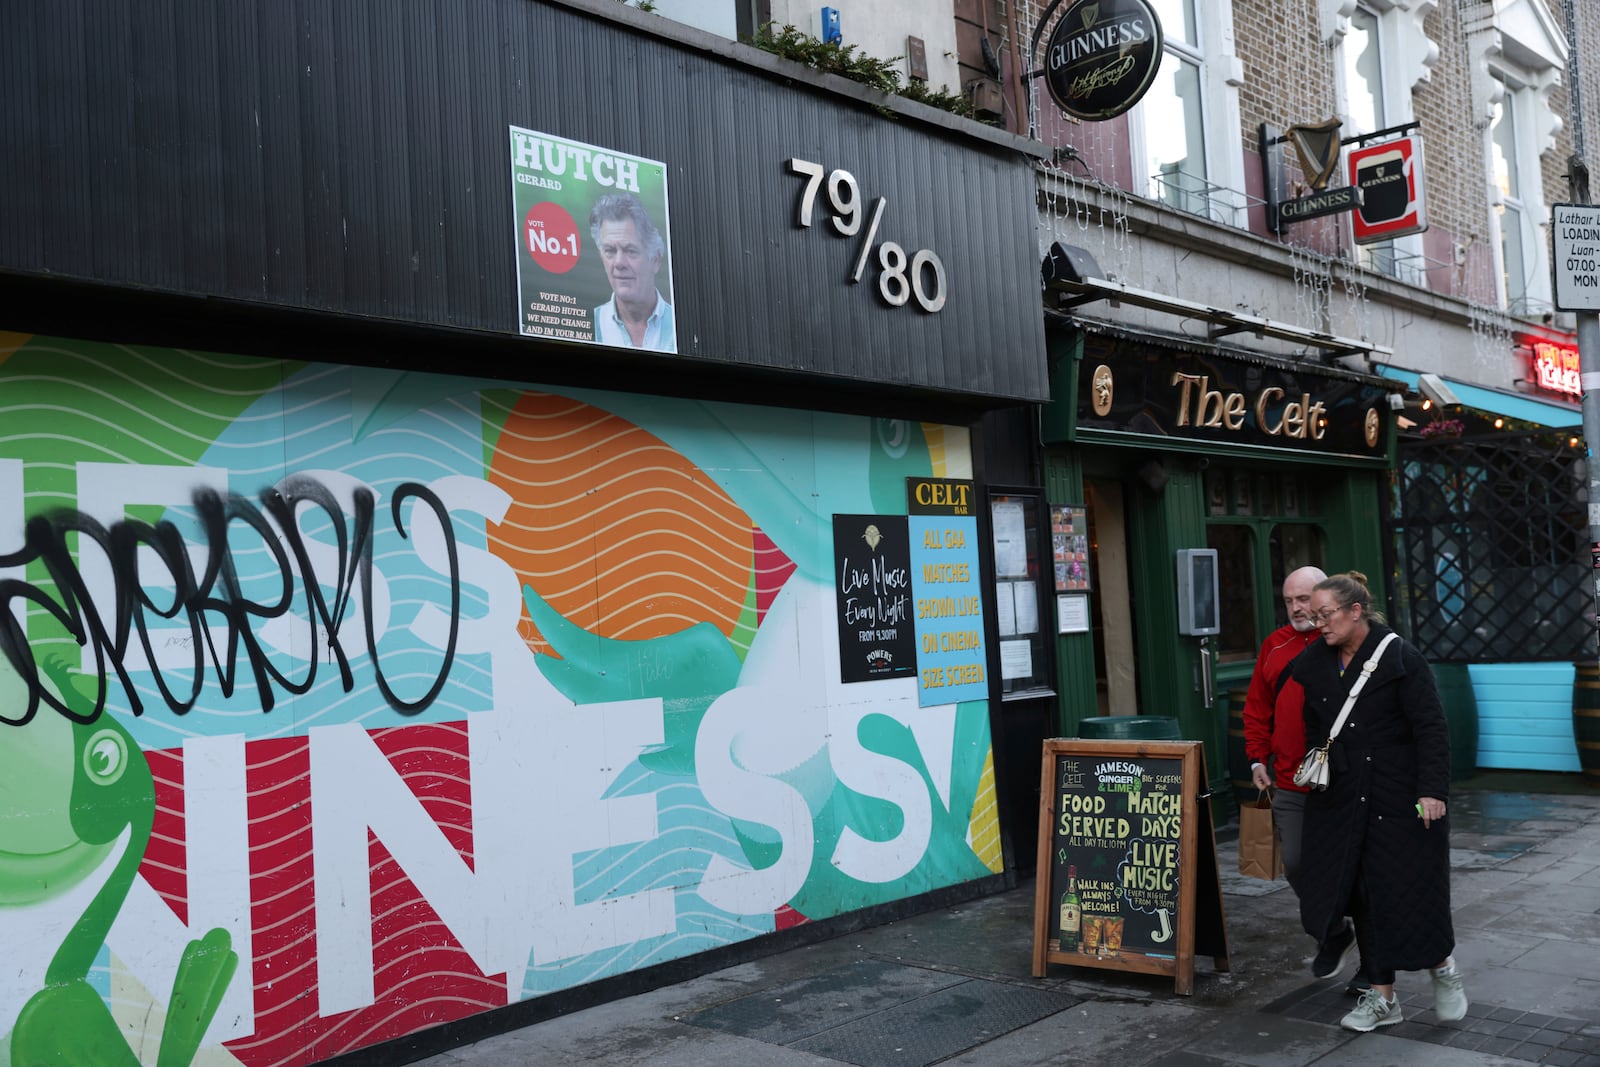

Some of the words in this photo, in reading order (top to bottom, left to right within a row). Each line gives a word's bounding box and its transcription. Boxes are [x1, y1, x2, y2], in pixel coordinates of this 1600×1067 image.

[1050, 20, 1145, 70] GUINNESS
[514, 133, 640, 193] HUTCH
[517, 173, 562, 191] GERARD
[1362, 174, 1401, 188] GUINNESS
[1281, 190, 1350, 217] GUINNESS
[528, 219, 545, 228] VOTE
[528, 228, 578, 257] No.1
[1571, 243, 1594, 256] Luan
[1574, 275, 1598, 287] MON
[540, 291, 559, 302] VOTE
[530, 302, 560, 313] GERARD
[561, 306, 587, 317] HUTCH
[527, 313, 540, 323] WE
[540, 315, 560, 325] NEED
[561, 318, 592, 329] CHANGE
[526, 325, 543, 334] AND
[543, 327, 554, 336] IM
[555, 328, 574, 339] YOUR
[575, 331, 593, 341] MAN
[1171, 371, 1247, 431] The
[1256, 386, 1327, 440] Celt
[915, 482, 970, 506] CELT
[954, 505, 968, 515] BAR
[923, 528, 942, 549] ALL
[944, 528, 967, 549] GAA
[842, 557, 870, 594] Live
[872, 554, 908, 595] Music
[923, 562, 971, 584] MATCHES
[844, 597, 876, 628] Every
[877, 594, 909, 626] Night
[917, 596, 956, 619] SHOWN
[957, 595, 980, 617] LIVE
[859, 629, 875, 642] FROM
[922, 632, 938, 653] ON
[940, 630, 981, 653] CINEMA
[866, 649, 893, 664] POWERS
[922, 667, 945, 689] SIZE
[946, 664, 985, 687] SCREEN
[1061, 760, 1080, 773] THE
[1094, 761, 1142, 777] JAMESON
[1098, 775, 1134, 784] GINGER
[1098, 782, 1105, 793] &
[1107, 783, 1132, 793] LIME
[1142, 774, 1154, 783] BIG
[1155, 774, 1182, 784] SCREENS
[1062, 794, 1105, 814] FOOD
[1128, 791, 1181, 815] MATCH
[1059, 813, 1130, 838] SERVED
[1142, 815, 1181, 839] DAYS
[1069, 836, 1082, 846] ALL
[1084, 838, 1097, 847] DAY
[1133, 842, 1176, 868] LIVE
[1077, 879, 1099, 890] WALK
[1101, 882, 1114, 891] INS
[1123, 866, 1173, 891] MUSIC
[1082, 891, 1112, 902] ALWAYS
[1127, 889, 1145, 898] EVERY
[1147, 891, 1168, 901] NIGHT
[1081, 901, 1120, 913] WELCOME!
[1151, 908, 1174, 943] J
